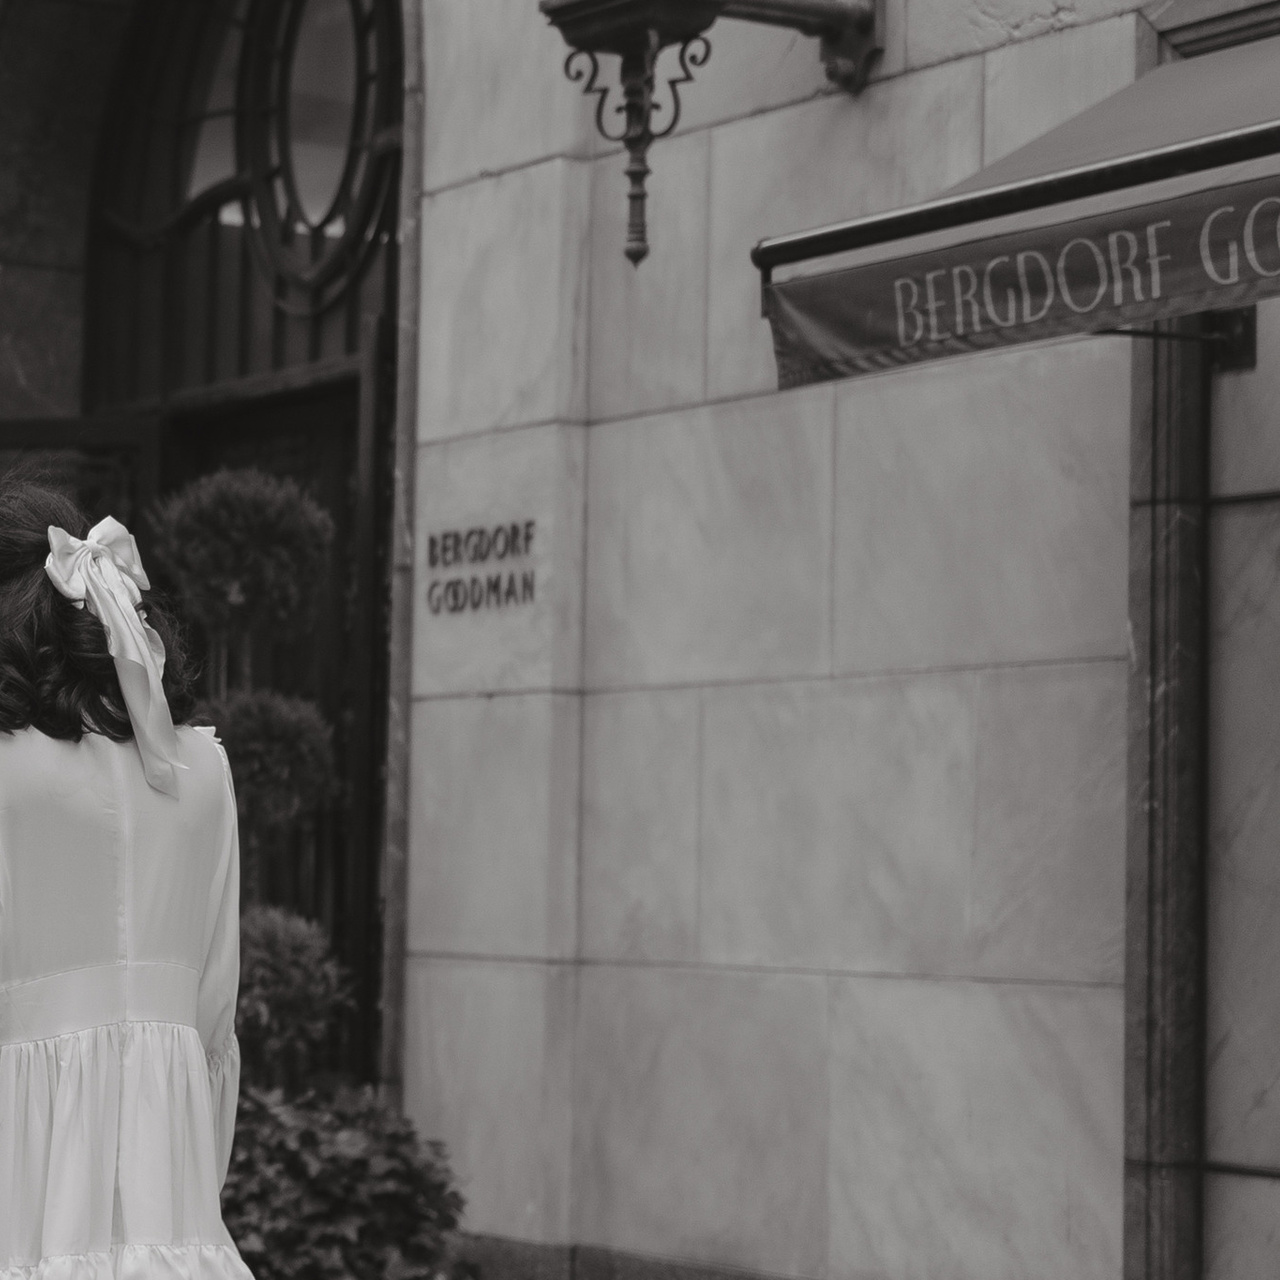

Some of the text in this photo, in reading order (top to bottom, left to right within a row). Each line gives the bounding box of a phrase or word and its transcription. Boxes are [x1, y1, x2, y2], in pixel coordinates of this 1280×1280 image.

[893, 196, 1280, 349] BERGDORF GO
[427, 569, 535, 615] GOODMAN
